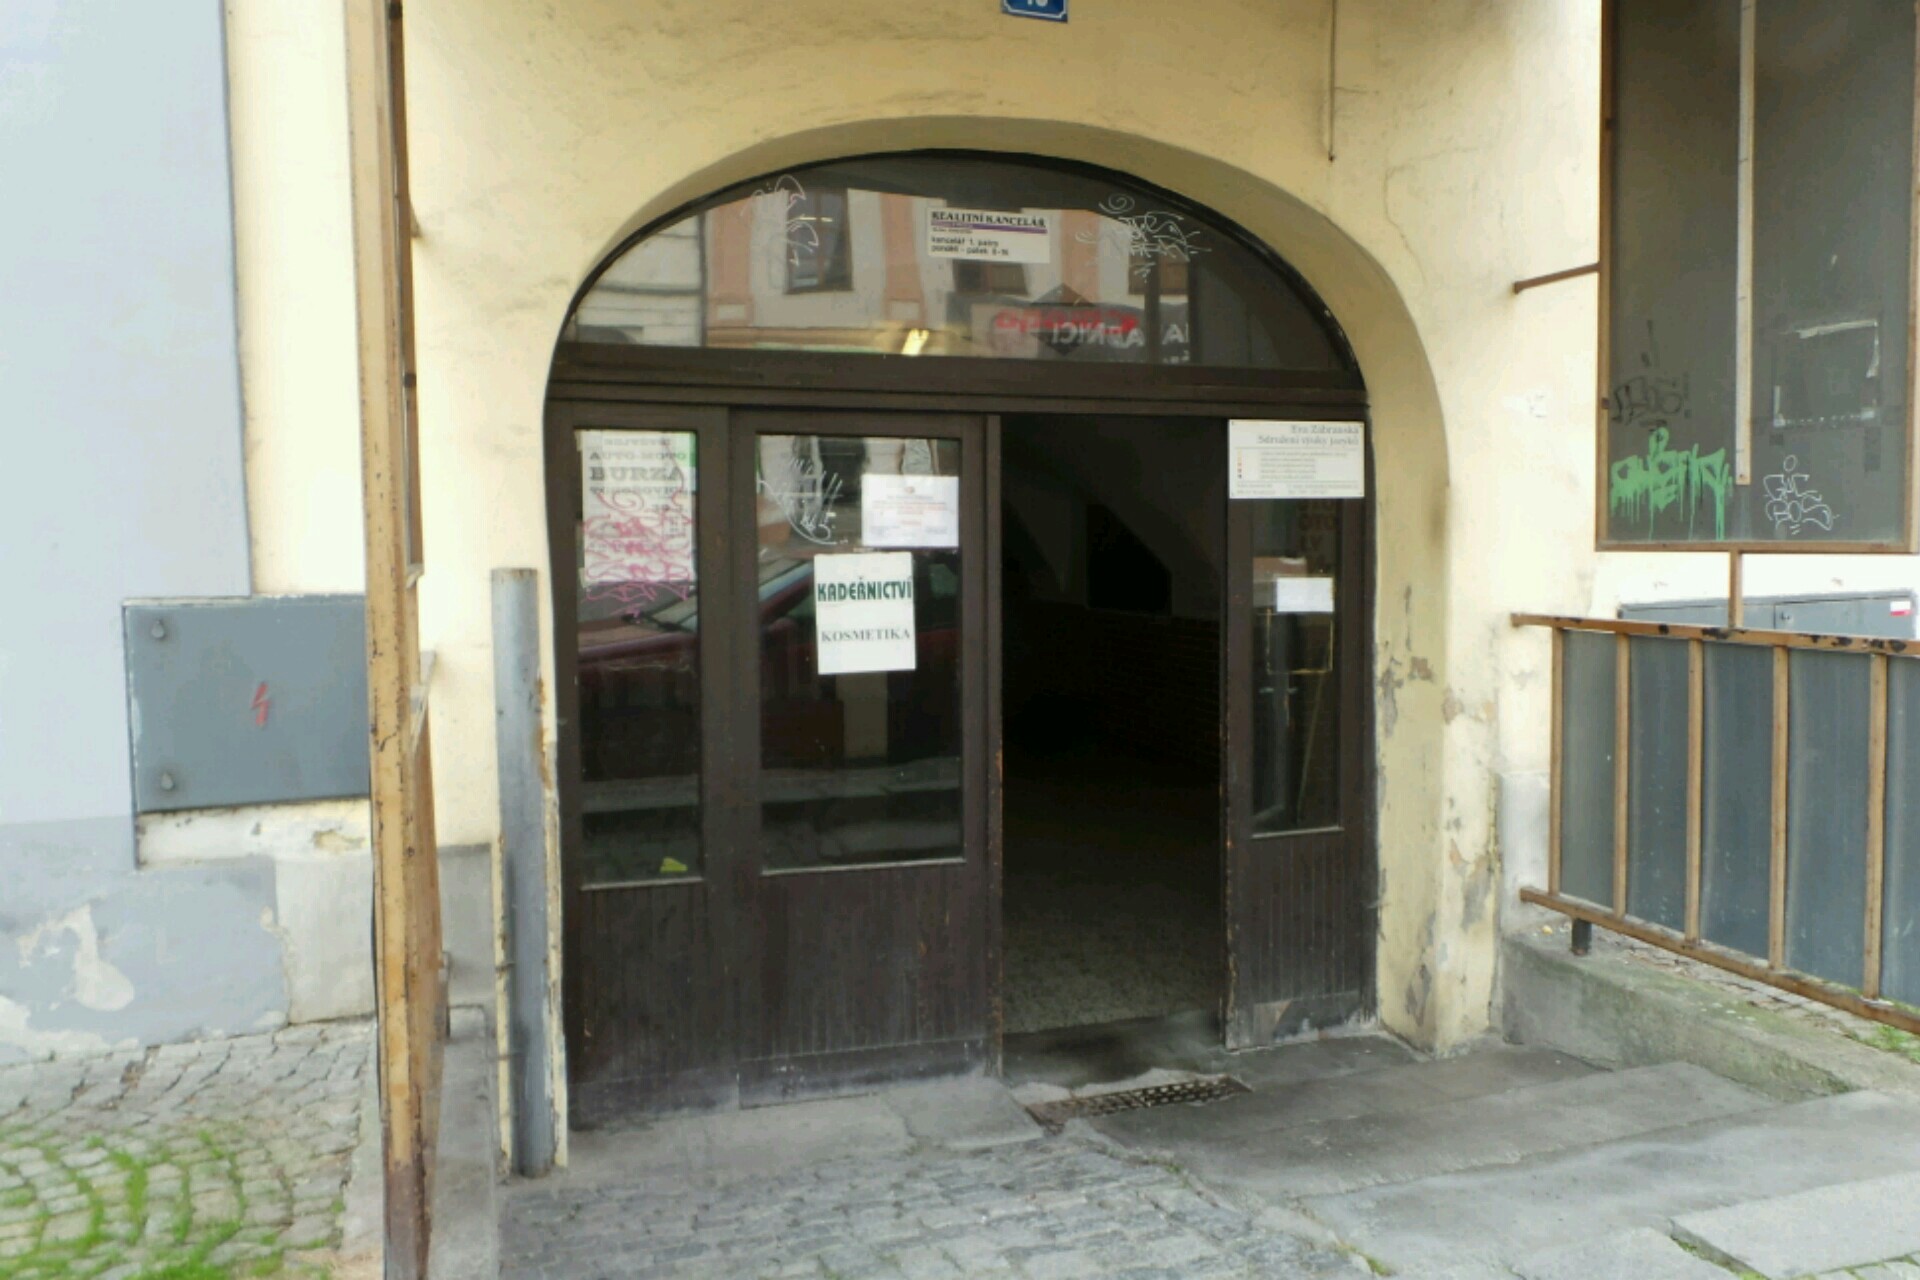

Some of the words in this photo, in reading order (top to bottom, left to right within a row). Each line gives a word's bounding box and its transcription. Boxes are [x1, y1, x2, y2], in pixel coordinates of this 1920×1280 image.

[985, 213, 1046, 228] KANCELÁŘ
[589, 466, 682, 482] BURZA
[818, 576, 912, 602] KADEŘNICTVÍ
[821, 628, 910, 643] KOSMETIKA
